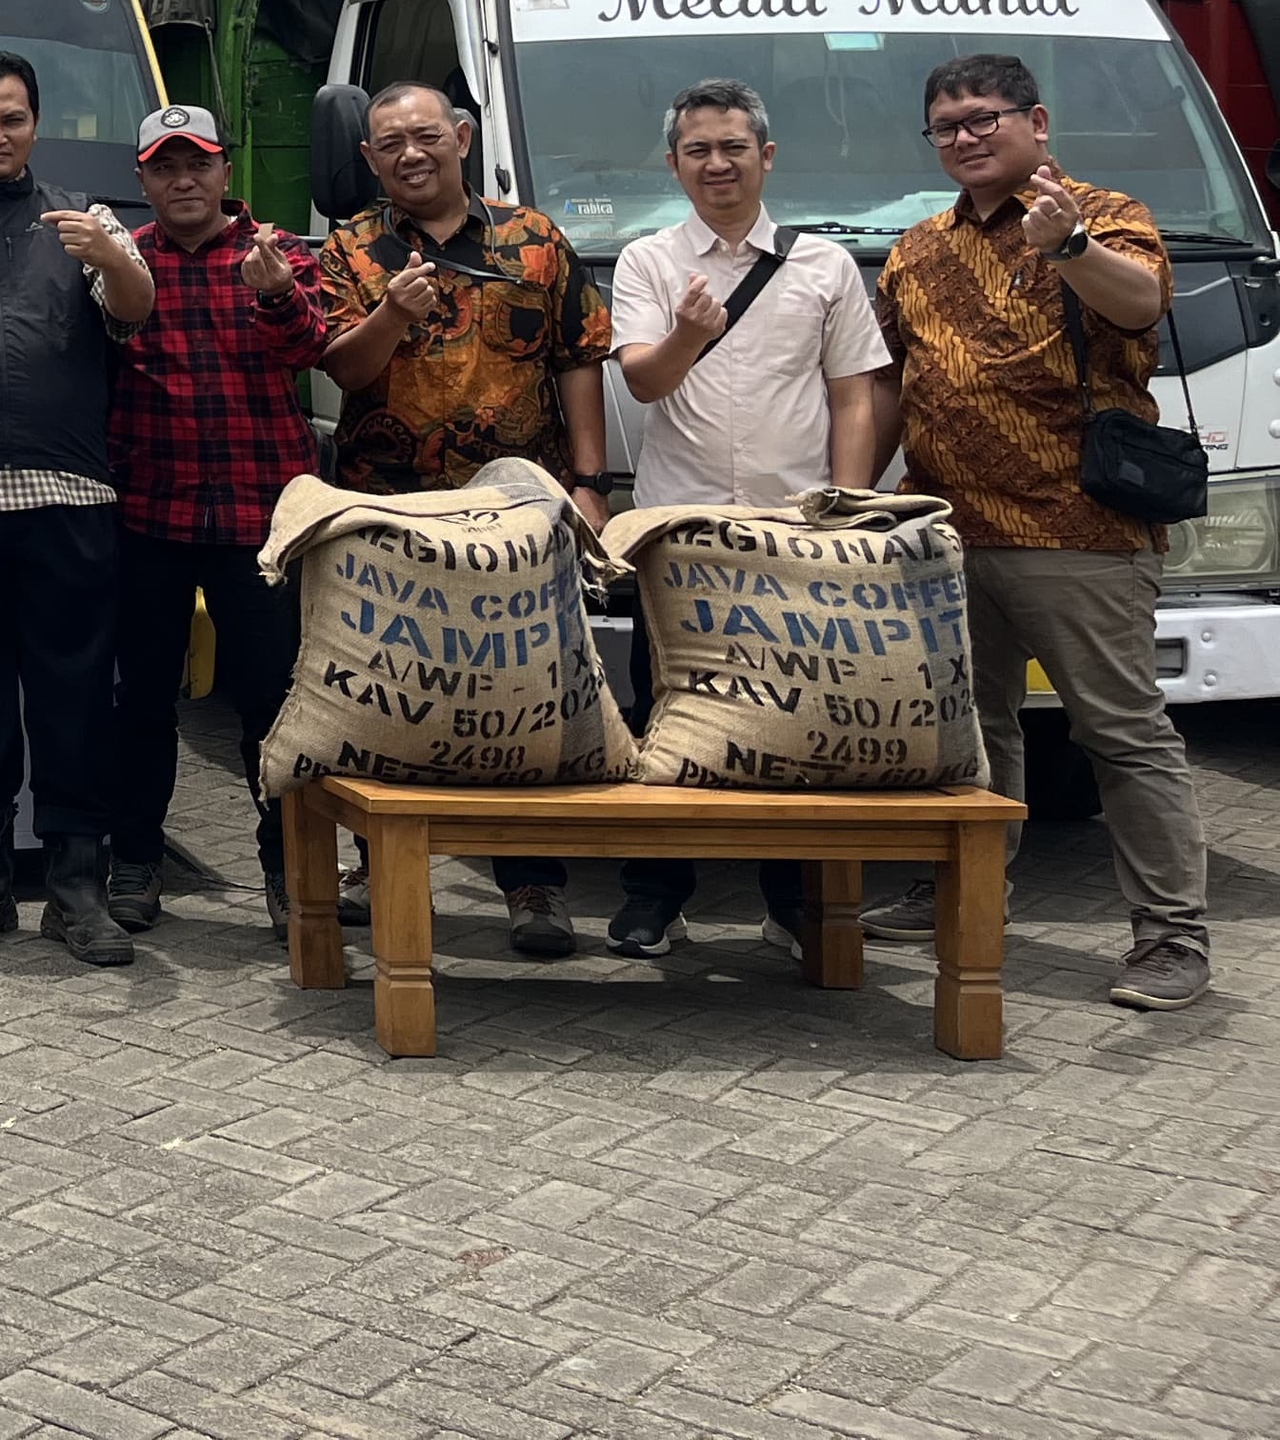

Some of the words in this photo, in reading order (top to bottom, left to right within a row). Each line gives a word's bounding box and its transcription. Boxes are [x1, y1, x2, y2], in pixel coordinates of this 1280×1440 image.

[336, 552, 450, 617] JAVA
[663, 561, 789, 602] JAVA
[680, 598, 964, 656] JAMPIT
[324, 660, 436, 725] KAV
[689, 670, 802, 714] KAV
[806, 730, 908, 766] 2499
